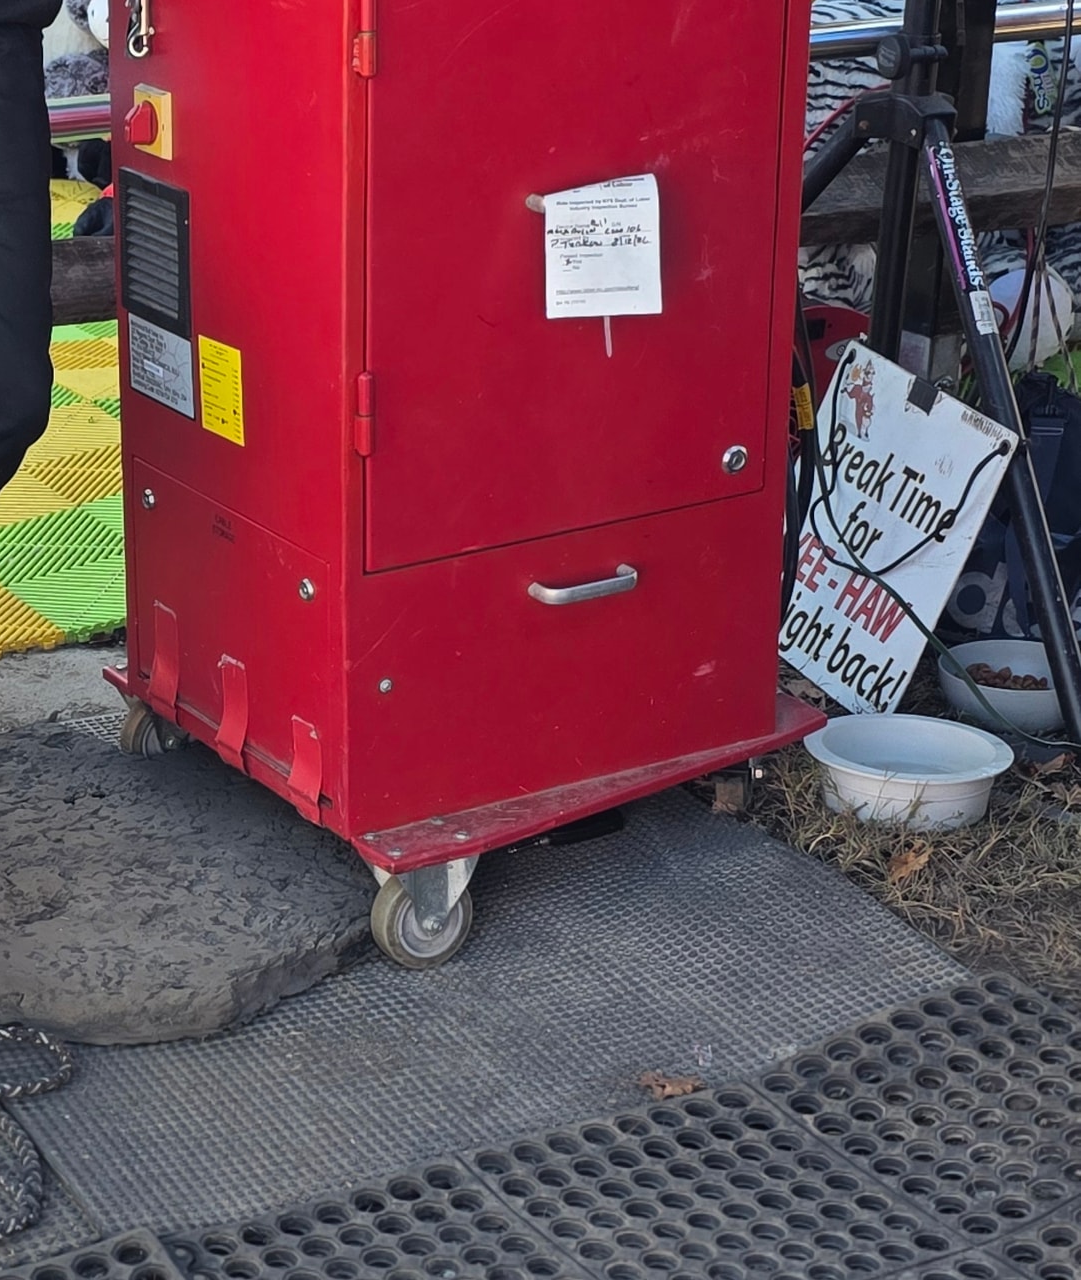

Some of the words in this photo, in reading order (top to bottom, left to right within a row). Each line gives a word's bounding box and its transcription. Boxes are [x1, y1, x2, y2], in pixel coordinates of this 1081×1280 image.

[822, 422, 895, 504] Break
[888, 465, 958, 544] Time
[837, 500, 884, 560] for
[833, 571, 914, 645] HAW
[825, 625, 909, 714] back!
